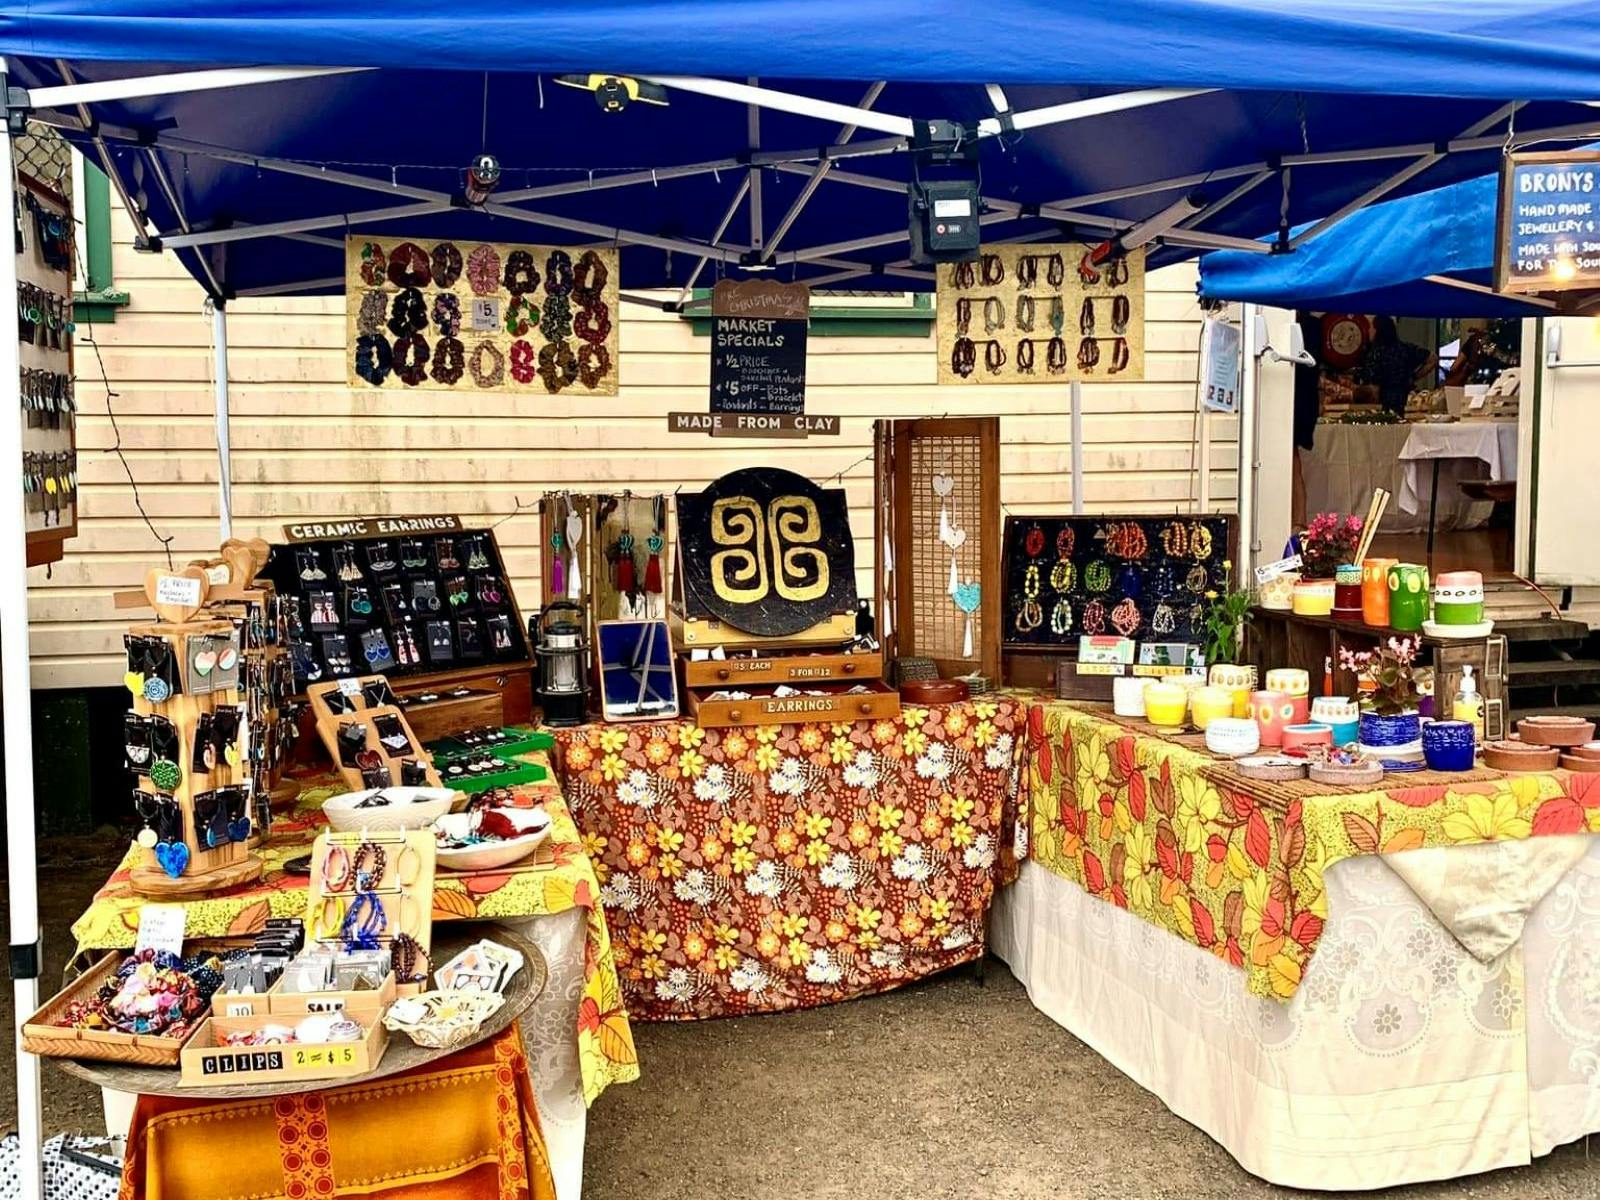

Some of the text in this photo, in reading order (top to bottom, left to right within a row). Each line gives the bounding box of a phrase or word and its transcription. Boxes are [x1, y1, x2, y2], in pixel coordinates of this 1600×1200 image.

[1520, 172, 1594, 193] BRONYS
[1518, 220, 1583, 236] JEWELLERY
[1518, 243, 1550, 256] MADE
[1517, 259, 1543, 271] FOR
[717, 319, 777, 333] MARKET
[717, 334, 785, 347] SPECIALS
[740, 354, 771, 367] PRICE
[741, 384, 760, 392] OFF
[767, 384, 789, 394] Pots
[677, 415, 834, 430] MADE FROM CLAY
[291, 516, 456, 538] CERAMIC EARRINGS
[749, 662, 771, 671] EACH
[790, 669, 796, 677] 3
[798, 668, 813, 677] FOR
[767, 699, 833, 713] EARRINGS
[205, 1053, 279, 1073] CLIPS
